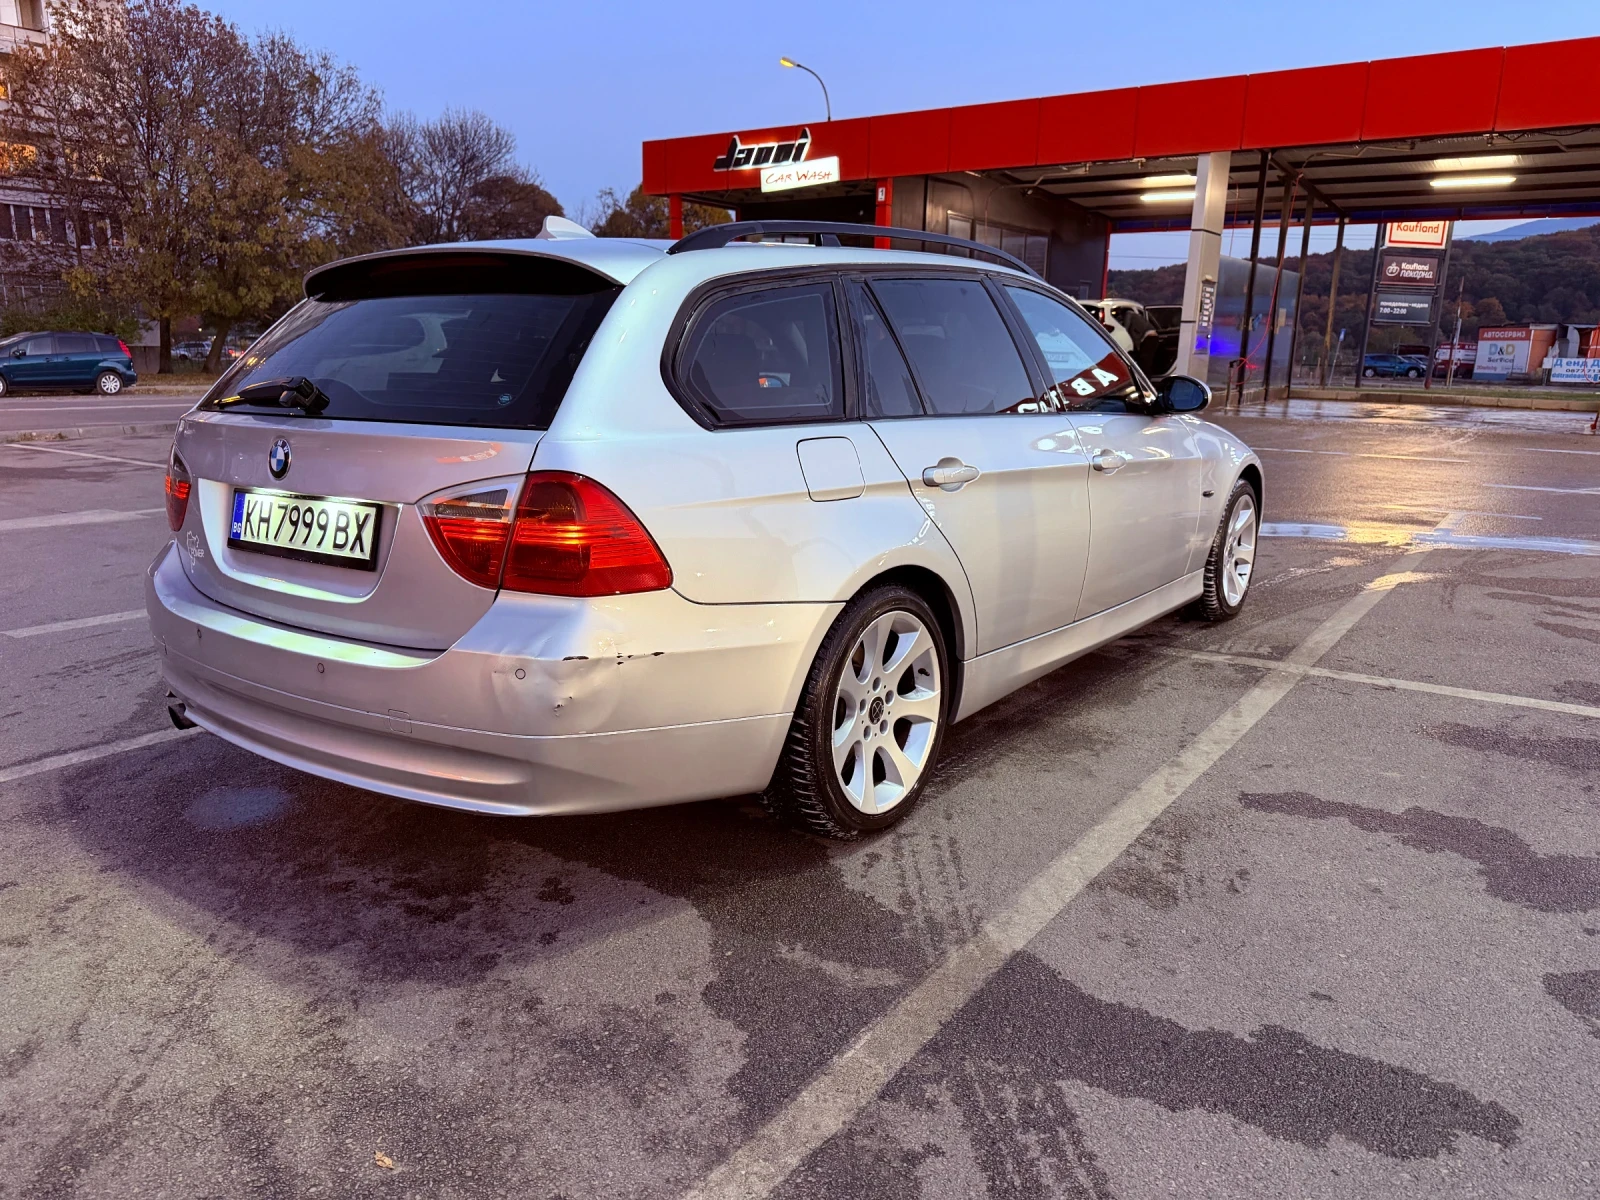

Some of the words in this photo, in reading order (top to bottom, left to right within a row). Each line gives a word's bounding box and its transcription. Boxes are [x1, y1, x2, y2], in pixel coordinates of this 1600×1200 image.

[765, 173, 792, 184] CAR
[796, 170, 832, 181] WASH
[1396, 222, 1440, 233] Kaufland
[1401, 262, 1429, 270] Kaufland
[1400, 270, 1433, 279] пекарна
[232, 522, 242, 533] BG
